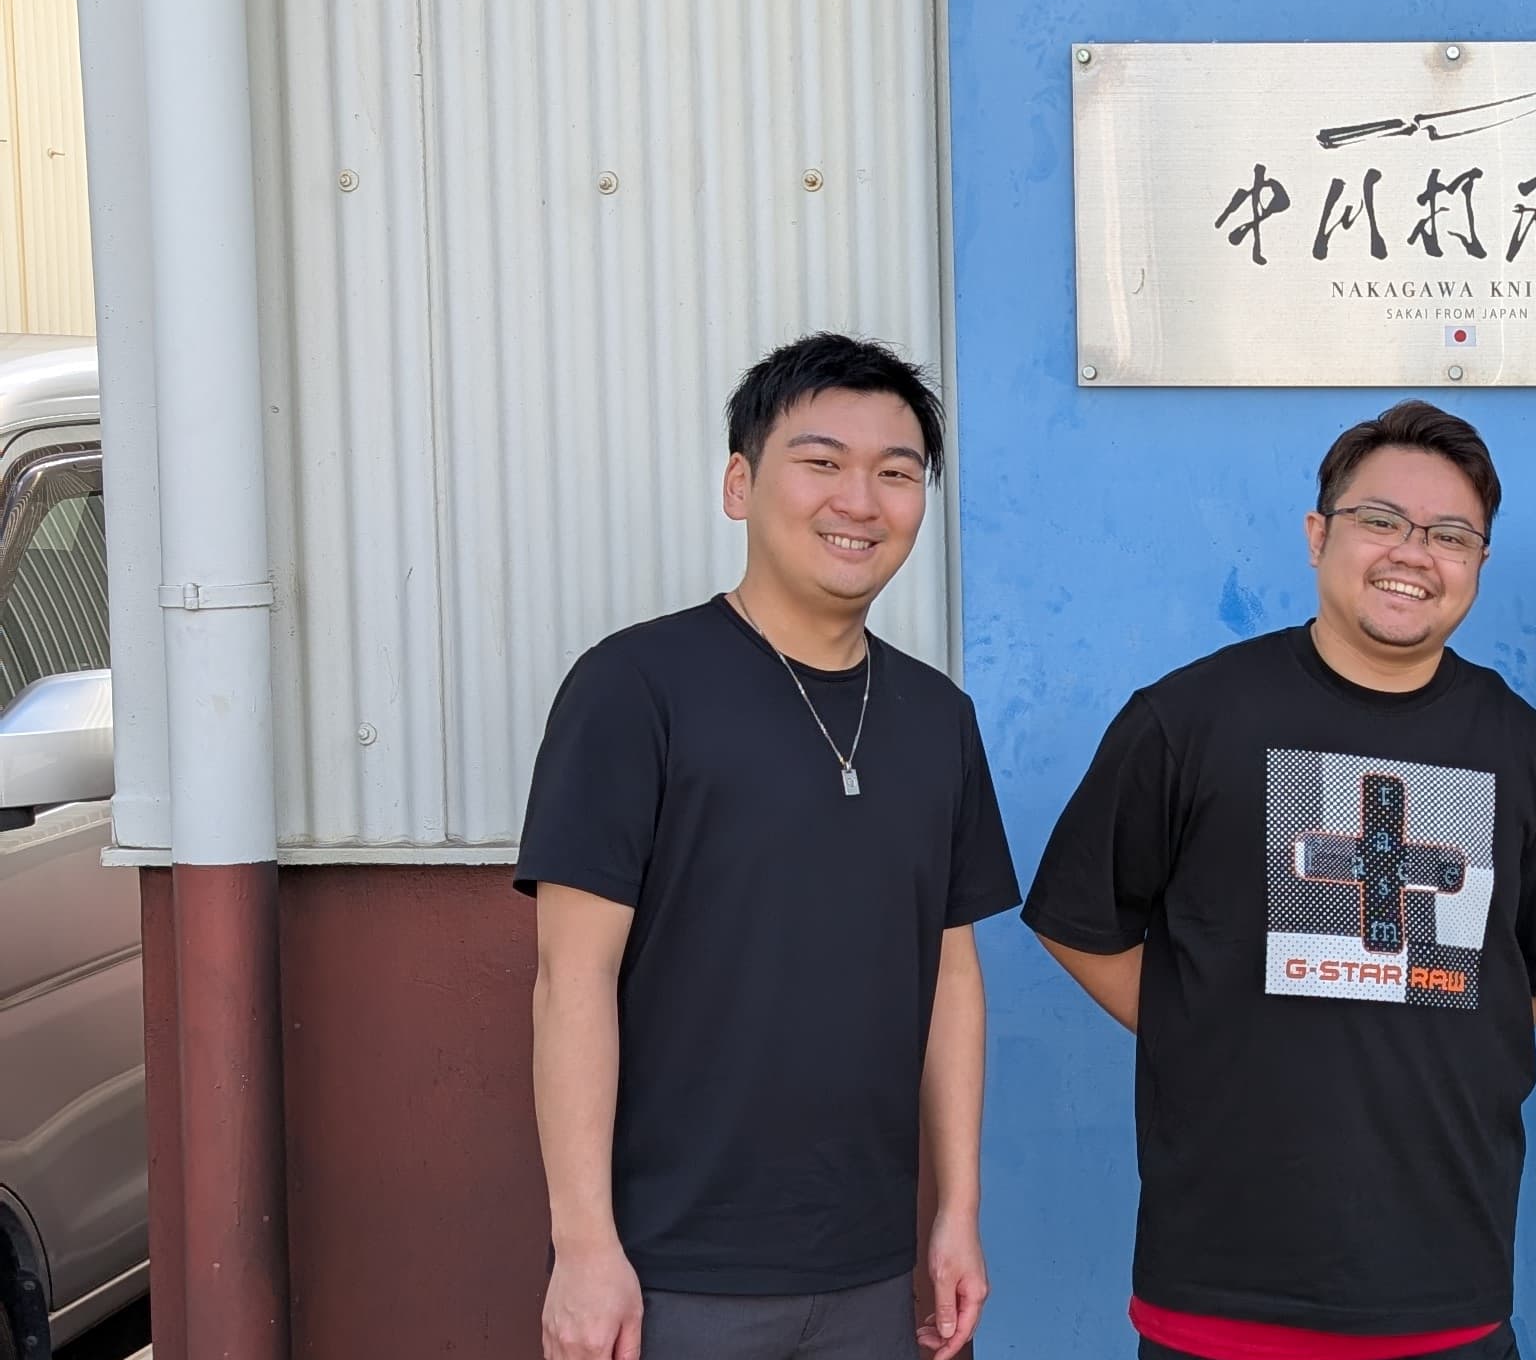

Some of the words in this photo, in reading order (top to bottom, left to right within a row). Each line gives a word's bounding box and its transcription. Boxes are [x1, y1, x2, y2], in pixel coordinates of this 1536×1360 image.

[1331, 280, 1474, 298] NAKAGAWA
[1386, 308, 1429, 320] SAKAI
[1435, 308, 1475, 320] FROM
[1482, 308, 1529, 320] JAPAN
[1284, 957, 1403, 986] G-STAR
[1409, 965, 1466, 993] RAW
